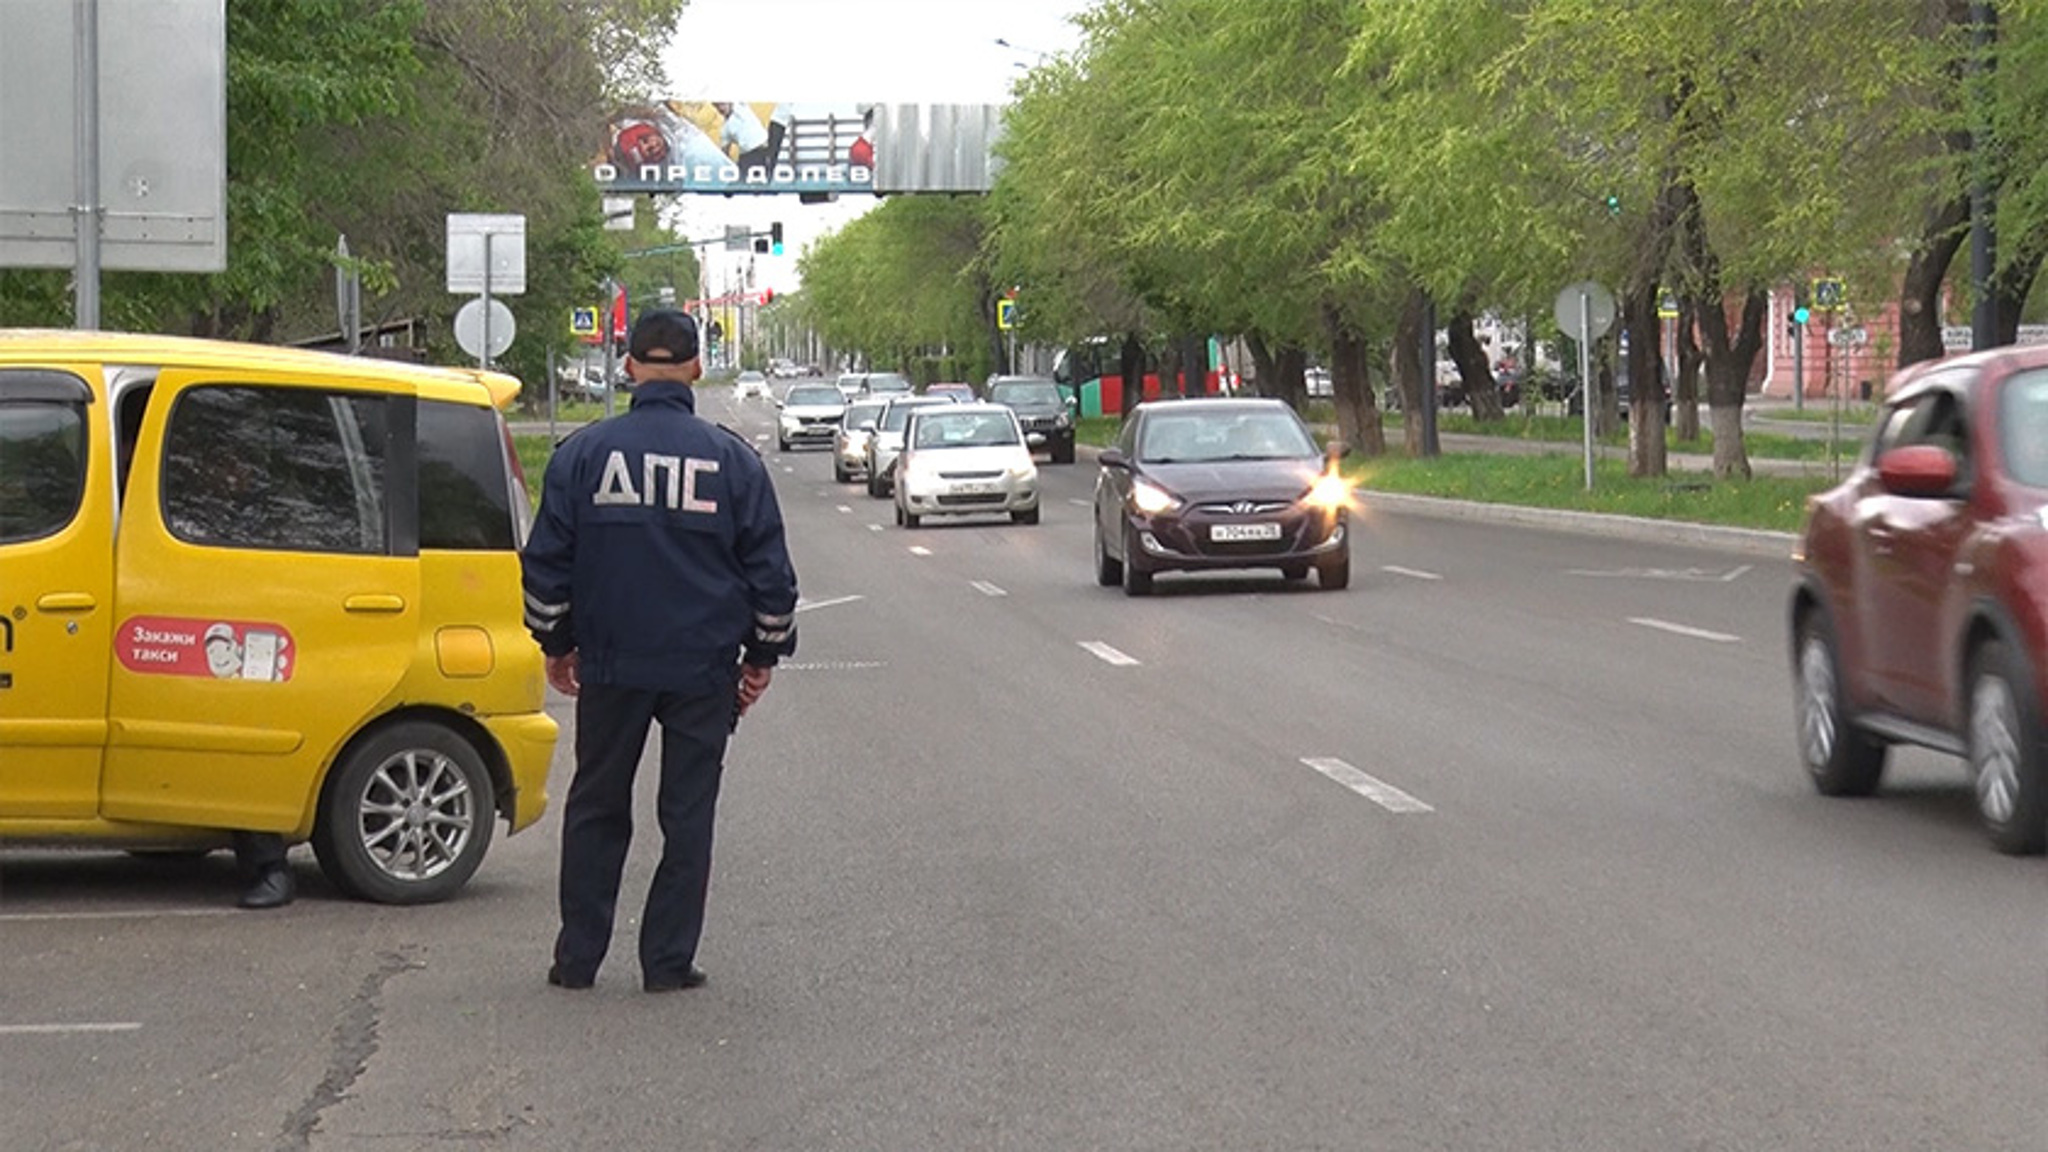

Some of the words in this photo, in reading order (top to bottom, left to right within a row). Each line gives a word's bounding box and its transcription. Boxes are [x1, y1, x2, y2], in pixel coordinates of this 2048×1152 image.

[592, 450, 720, 513] ДПС
[133, 626, 196, 646] Закажи
[132, 648, 179, 663] такси
